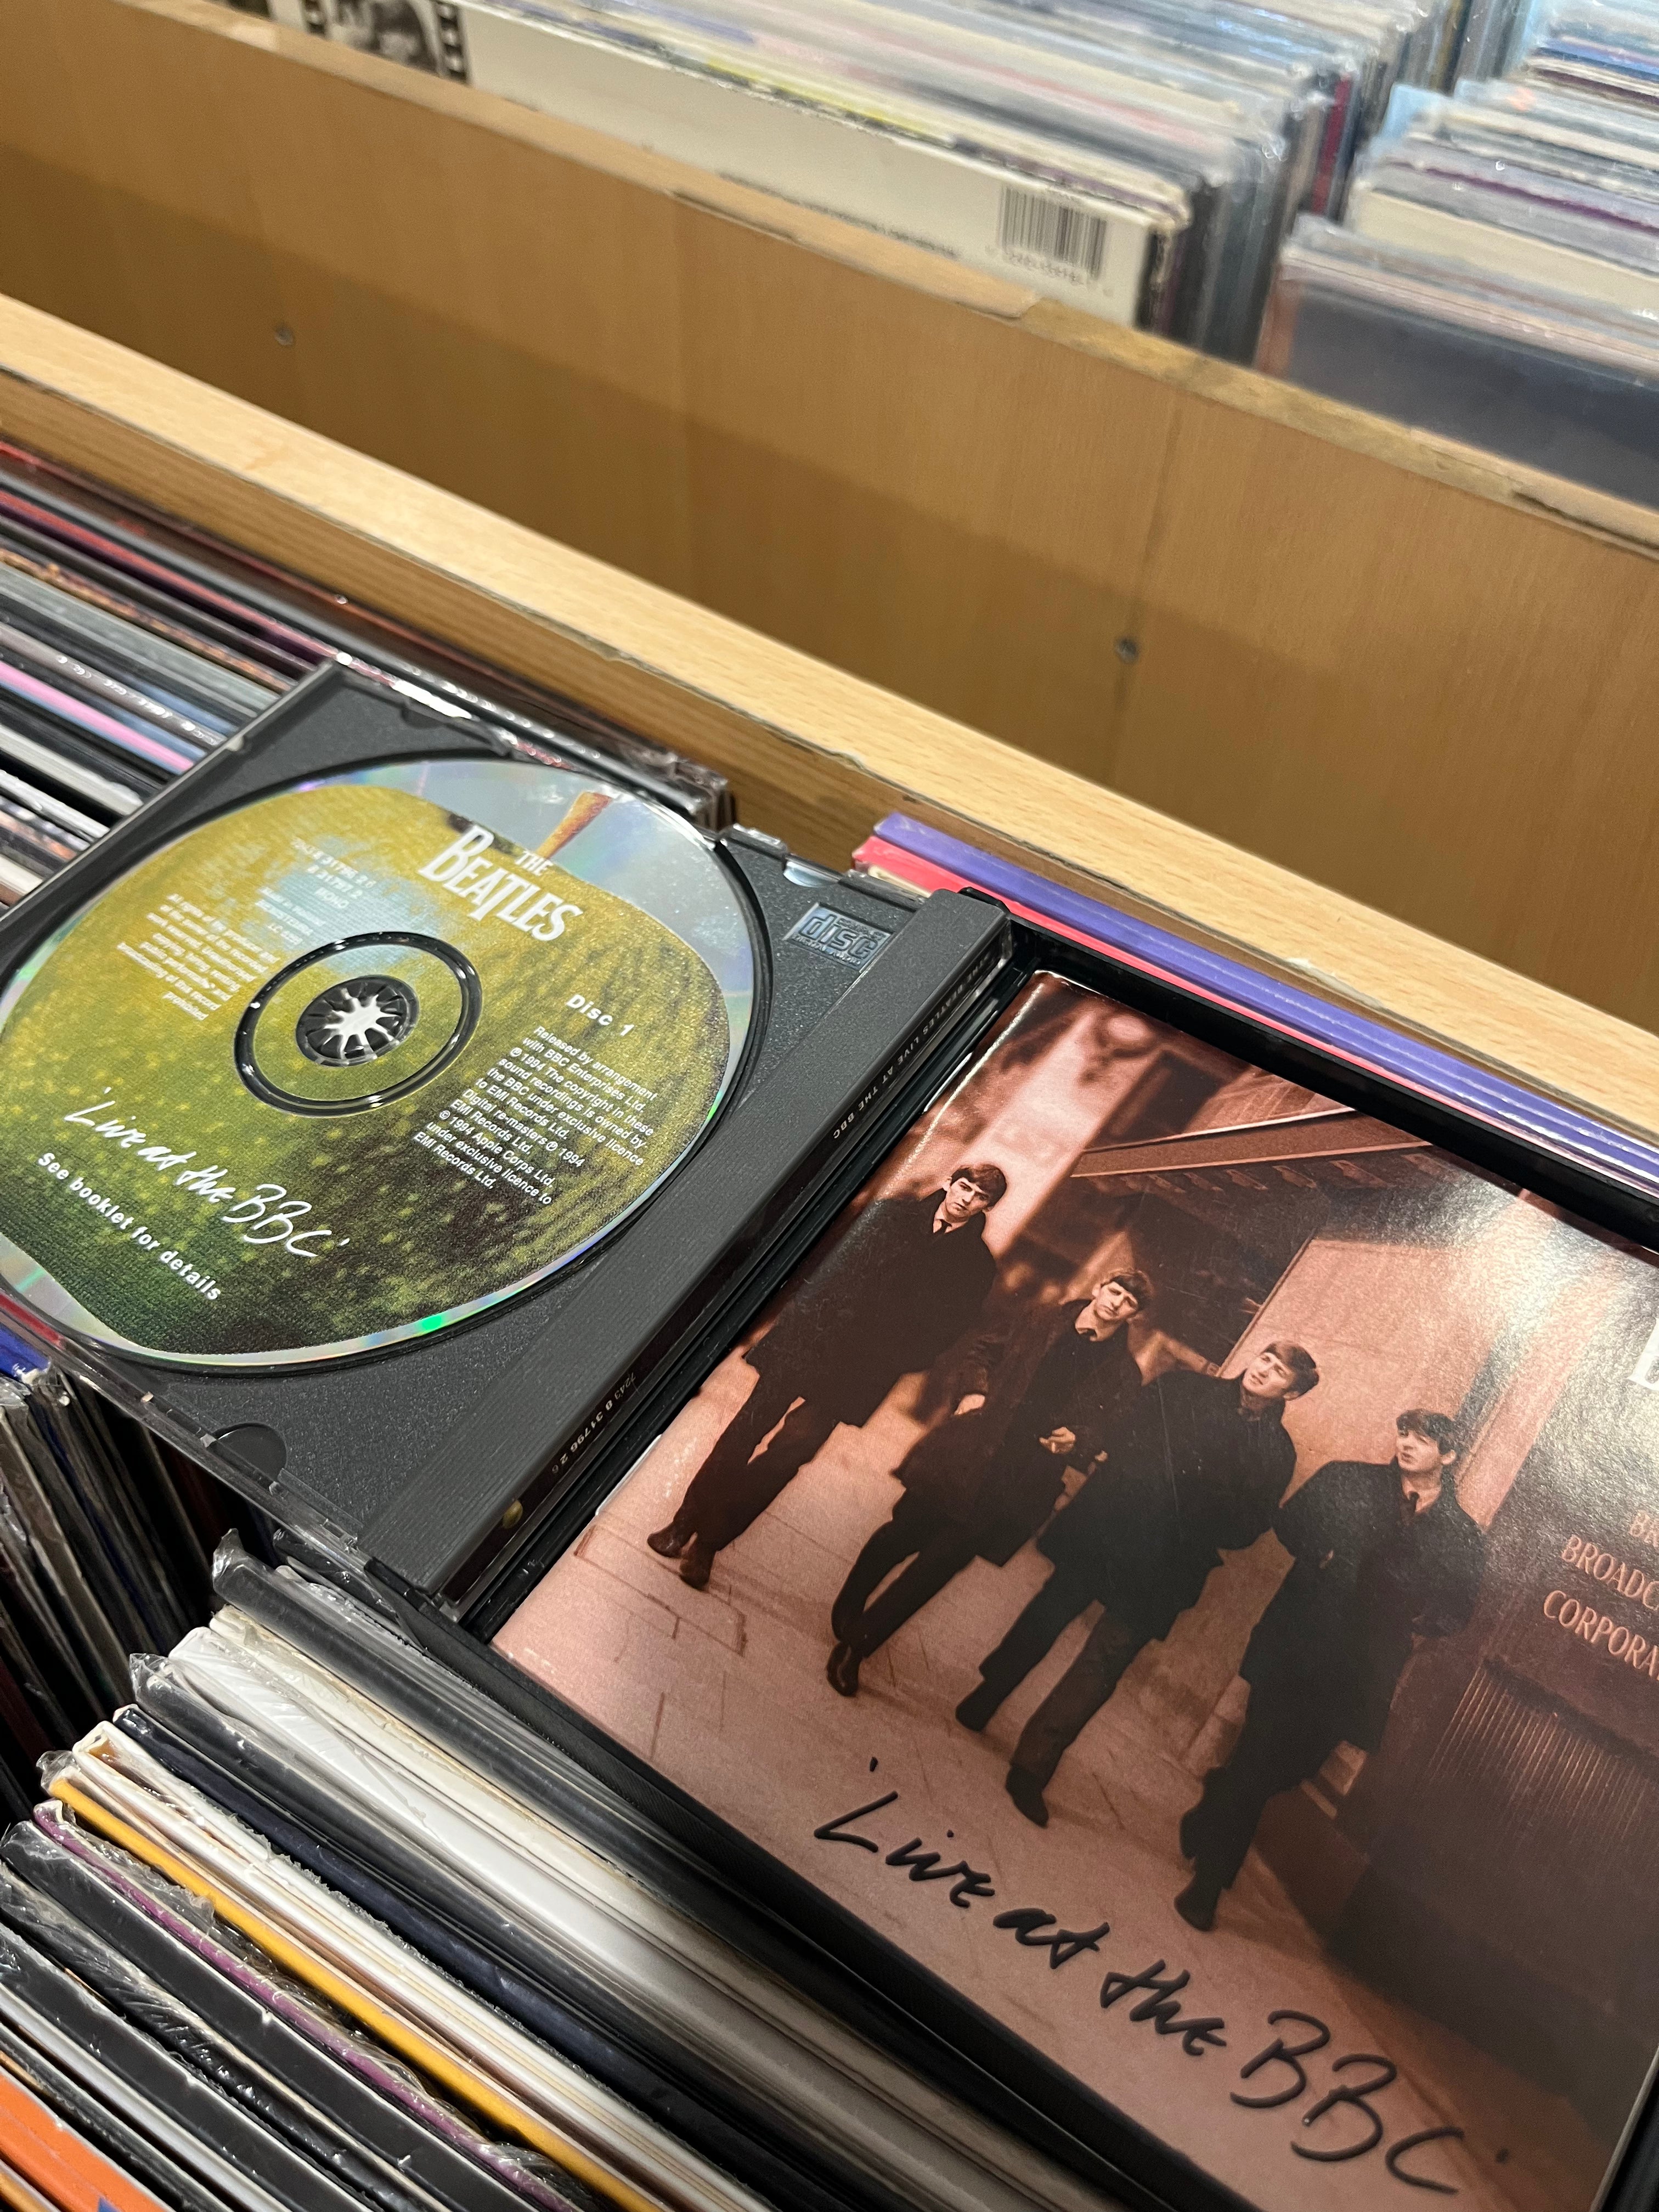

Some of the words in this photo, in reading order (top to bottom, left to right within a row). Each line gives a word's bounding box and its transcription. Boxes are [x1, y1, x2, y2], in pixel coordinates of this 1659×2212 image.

[418, 825, 583, 941] BEATLES
[515, 849, 554, 876] THE
[798, 913, 878, 960] disc
[566, 994, 613, 1026] Disc
[620, 1024, 635, 1036] 1
[523, 1037, 545, 1053] with
[544, 1049, 569, 1066] BBC
[568, 1063, 625, 1100] Enterprises
[624, 1096, 646, 1113] Ltd.
[534, 1026, 580, 1056] Released
[578, 1051, 594, 1065] by
[592, 1062, 658, 1101] arrangement
[882, 1066, 893, 1084] AT
[898, 1037, 919, 1065] LIVE
[476, 1078, 487, 1088] to
[487, 1085, 510, 1101] EMI
[506, 1097, 550, 1126] Records
[548, 1122, 570, 1139] Ltd.
[487, 1068, 505, 1081] the
[504, 1077, 529, 1095] BBC
[528, 1093, 559, 1114] under
[557, 1111, 606, 1142] exclusive
[605, 1138, 644, 1166] licence
[498, 1058, 532, 1080] sound
[530, 1077, 584, 1111] recordings
[583, 1107, 595, 1118] is
[595, 1116, 633, 1139] owned
[630, 1134, 646, 1149] by
[521, 1053, 546, 1071] 1994
[545, 1066, 564, 1083] The
[564, 1080, 614, 1112] copyright
[612, 1107, 624, 1118] in
[624, 1115, 654, 1136] these
[859, 1086, 878, 1110] THE
[449, 1116, 475, 1135] 1994
[472, 1132, 503, 1154] Apple
[503, 1150, 534, 1174] Corps
[533, 1169, 556, 1188] Ltd.
[450, 1099, 473, 1115] EMI
[470, 1111, 513, 1141] Records
[512, 1136, 533, 1154] Ltd.
[462, 1088, 496, 1113] Digital
[493, 1109, 548, 1144] re-masters
[558, 1148, 585, 1167] 1994
[833, 1113, 854, 1139] BBC
[138, 1146, 197, 1171] at
[174, 1165, 236, 1203] the
[414, 1131, 437, 1148] EMI
[433, 1144, 476, 1175] Records
[475, 1170, 496, 1189] Ltd.
[426, 1121, 458, 1143] under
[455, 1141, 503, 1173] exclusive
[501, 1169, 539, 1196] licence
[539, 1193, 552, 1204] to
[69, 1177, 134, 1230] booklet
[132, 1227, 161, 1252] for
[160, 1251, 222, 1301] details
[606, 1400, 613, 1410] 8
[614, 1372, 636, 1400] 7243
[560, 1453, 568, 1464] 2
[571, 1412, 603, 1452] 31796
[992, 1907, 1110, 1970] at
[1099, 1959, 1227, 2056] the
